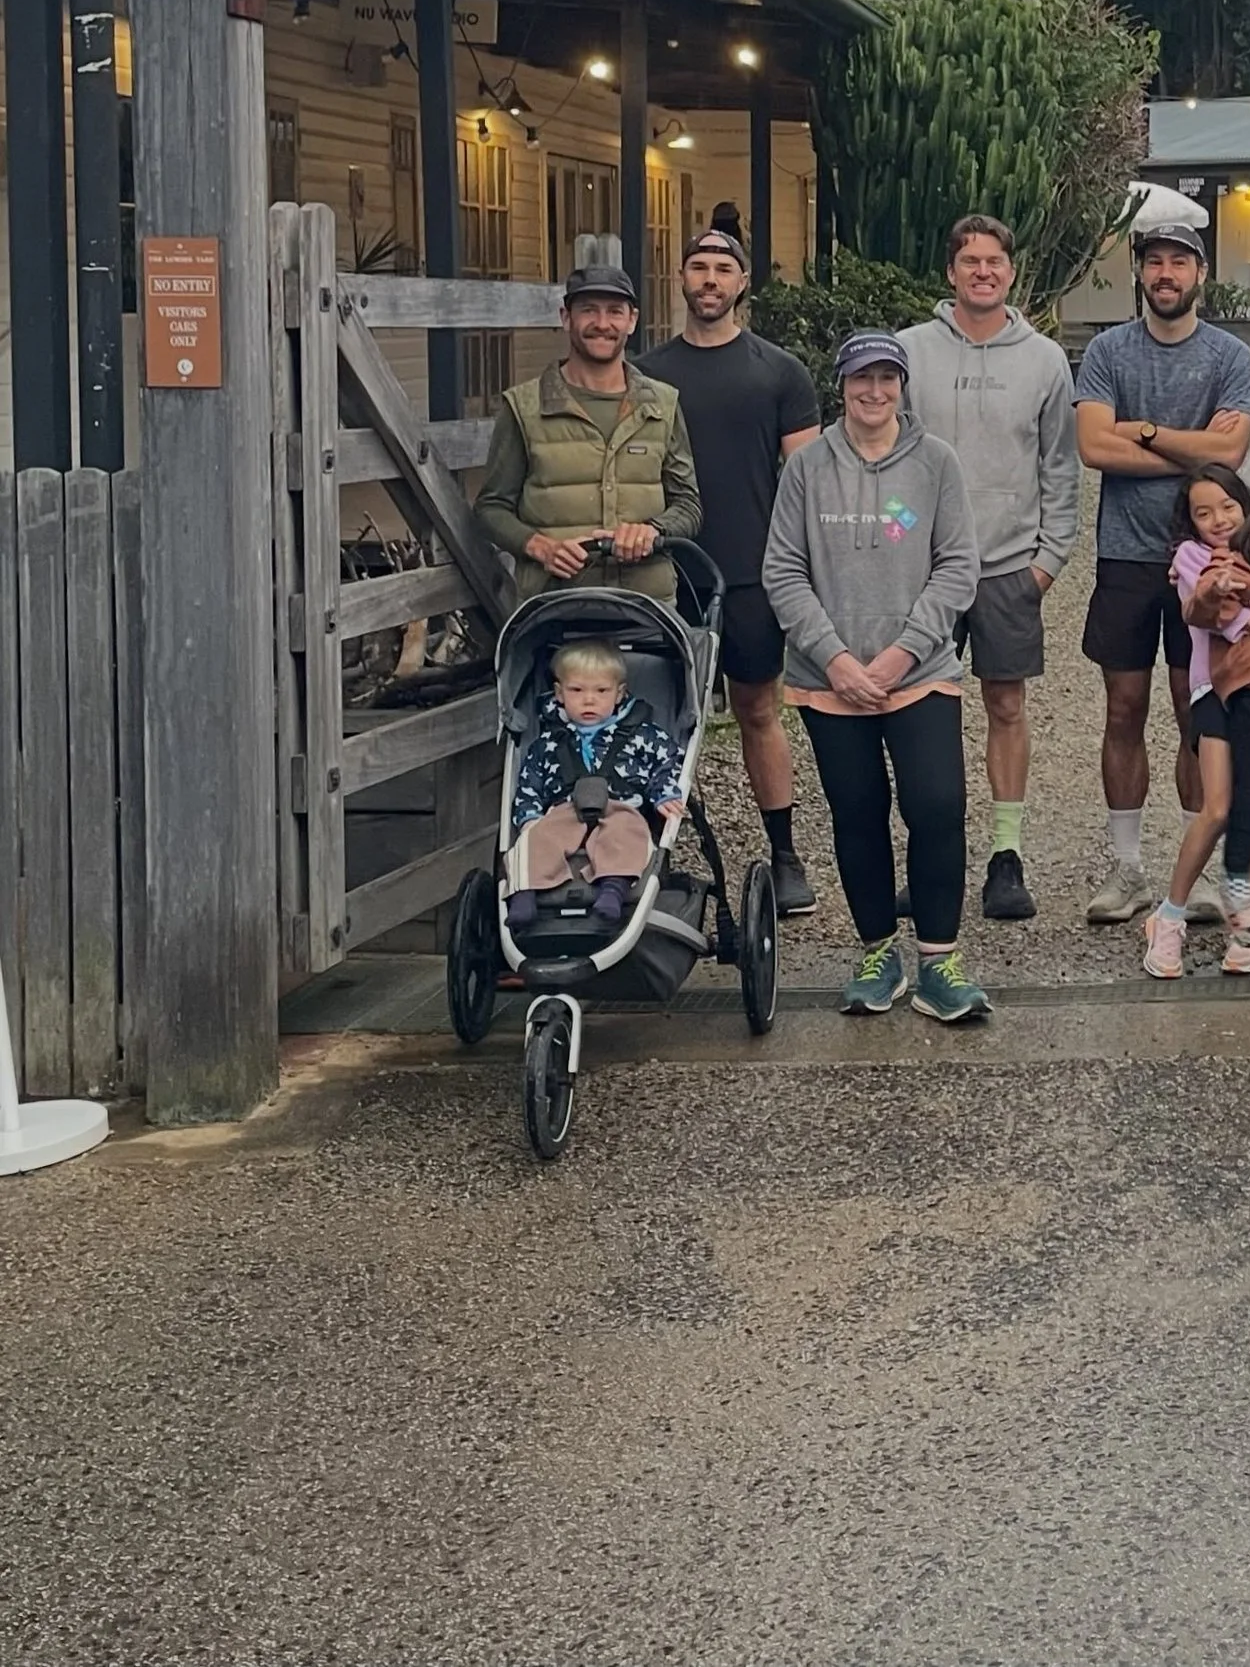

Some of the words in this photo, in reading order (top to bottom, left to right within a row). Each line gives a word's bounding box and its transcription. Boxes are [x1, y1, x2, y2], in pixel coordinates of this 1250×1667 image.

[354, 6, 375, 21] NU
[380, 7, 417, 23] WAV
[153, 278, 171, 292] NO
[172, 278, 211, 292] ENTRY
[158, 306, 207, 318] VISITORS
[169, 320, 198, 333] CARS
[169, 335, 199, 347] ONLY
